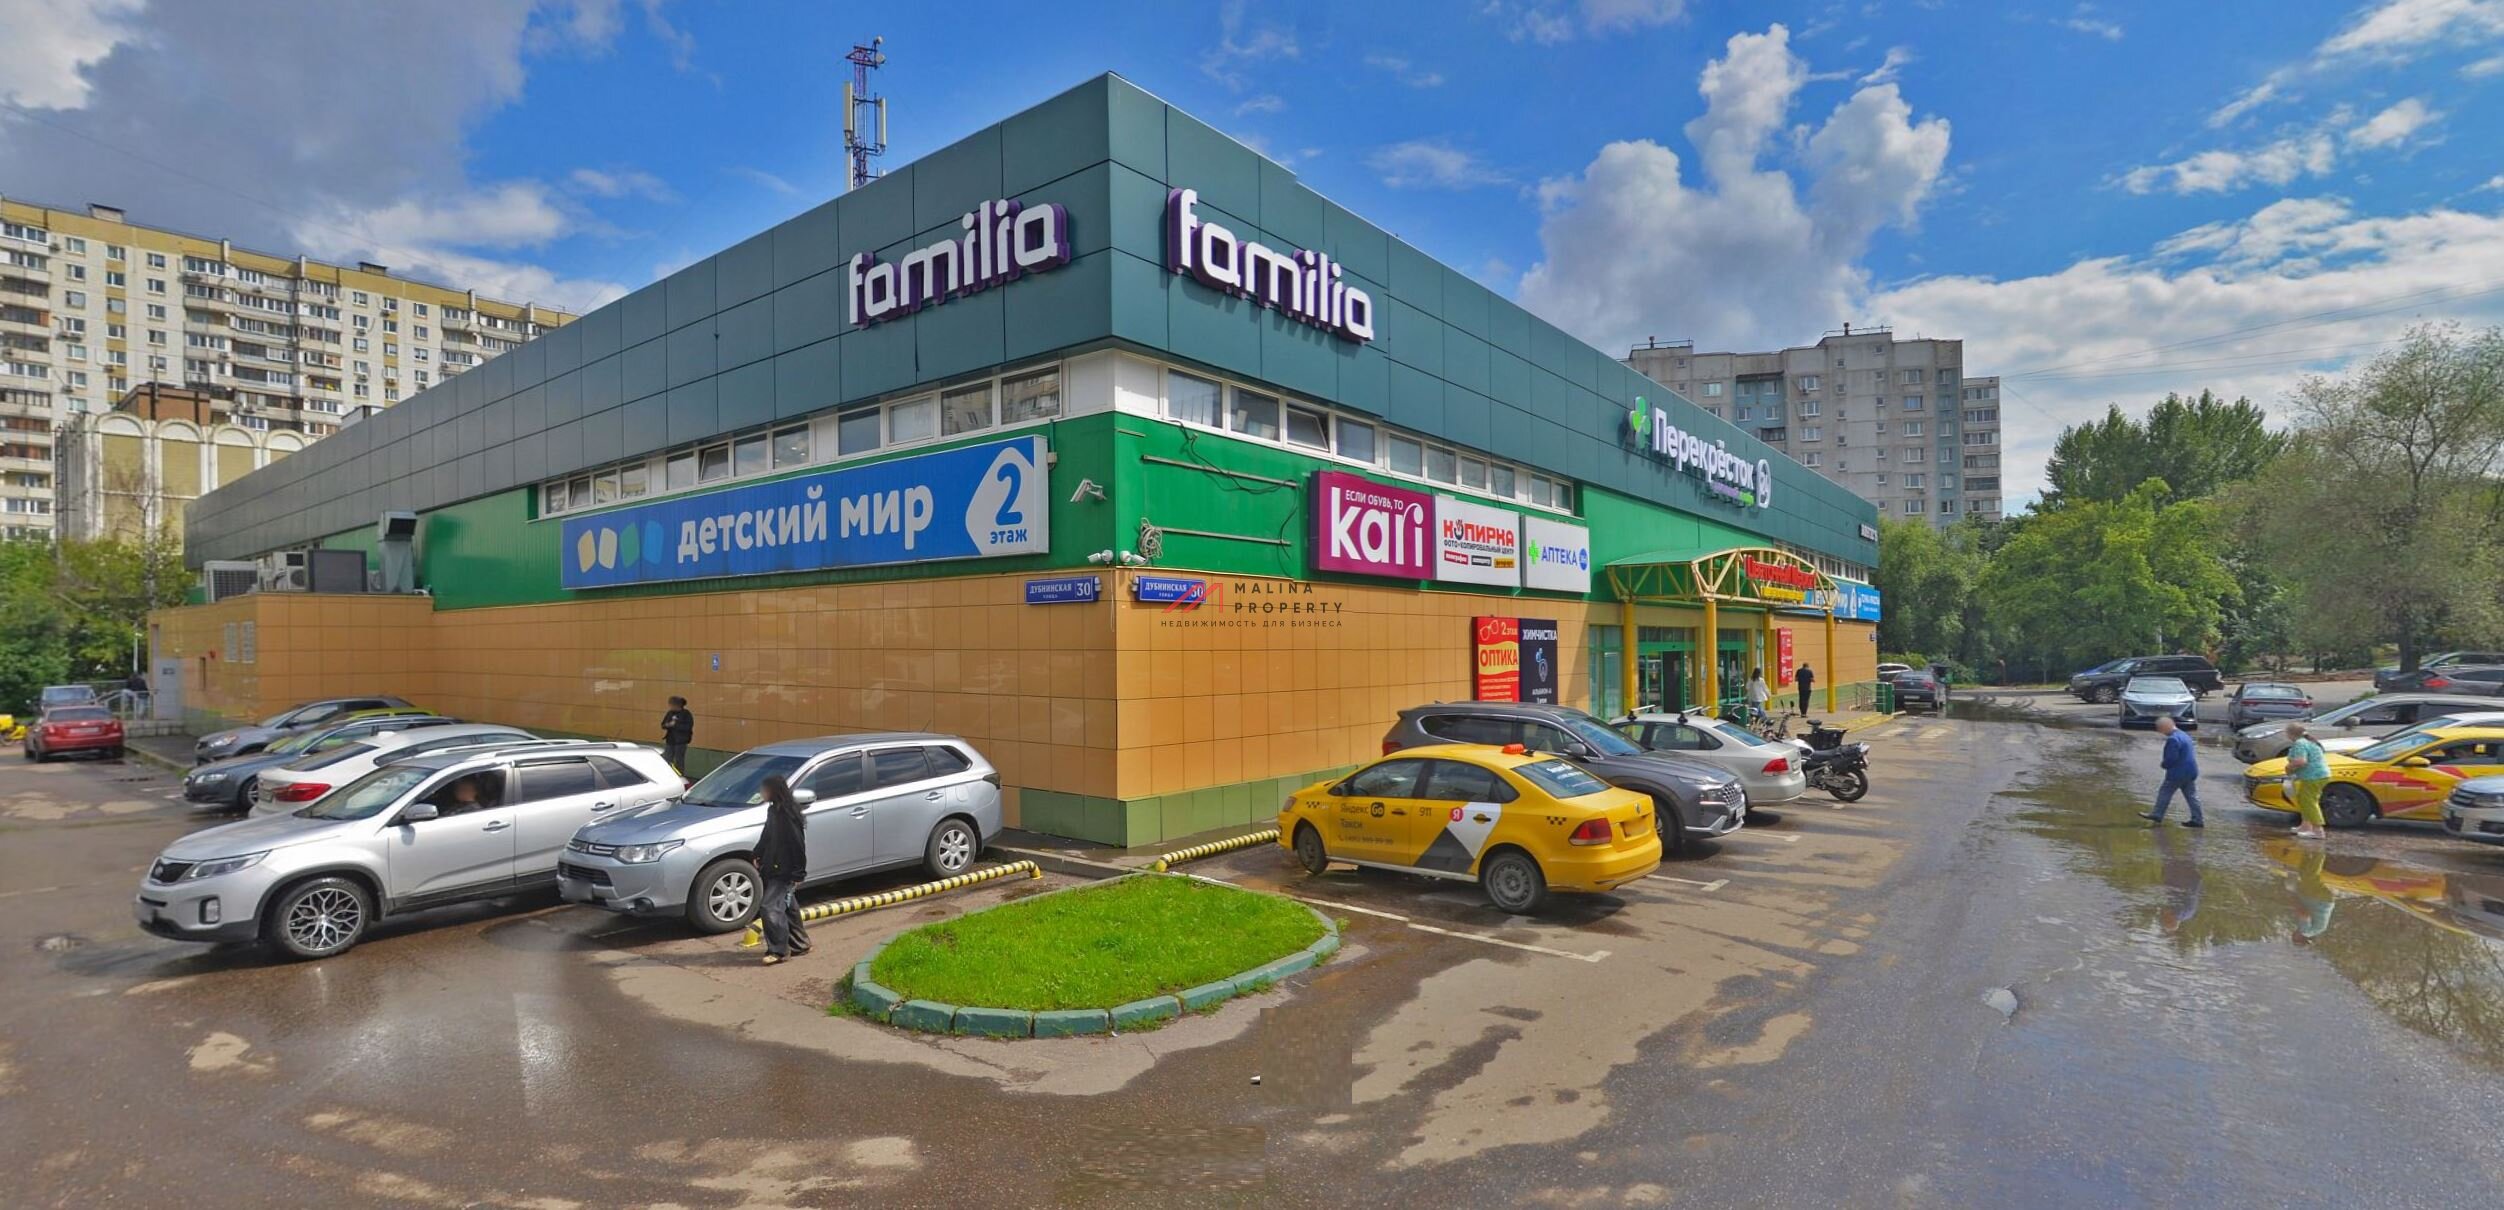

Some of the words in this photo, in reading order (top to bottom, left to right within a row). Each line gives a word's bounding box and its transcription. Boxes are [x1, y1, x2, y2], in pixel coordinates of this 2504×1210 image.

[849, 198, 1070, 325] familia
[1178, 188, 1374, 342] familia
[1653, 407, 1754, 490] Перекрёсток
[995, 461, 1023, 527] 2
[1345, 489, 1366, 504] ЕСЛИ
[1367, 494, 1393, 510] ОБУВЬ,
[1393, 499, 1404, 510] ТО
[678, 484, 827, 563] детский
[840, 482, 934, 551] мир
[1331, 486, 1424, 568] kari
[989, 527, 1029, 545] этаж
[1541, 546, 1578, 566] АПТЕКА
[1029, 582, 1072, 594] ДУБНИНСКАЯ
[1076, 582, 1091, 597] 30
[1144, 581, 1187, 593] ДУБНИНСКАЯ
[1501, 621, 1507, 636] 2
[1522, 628, 1558, 641] ХИМЧИСТКА
[1479, 648, 1518, 668] ОПТИКА
[1371, 803, 1384, 816] Go
